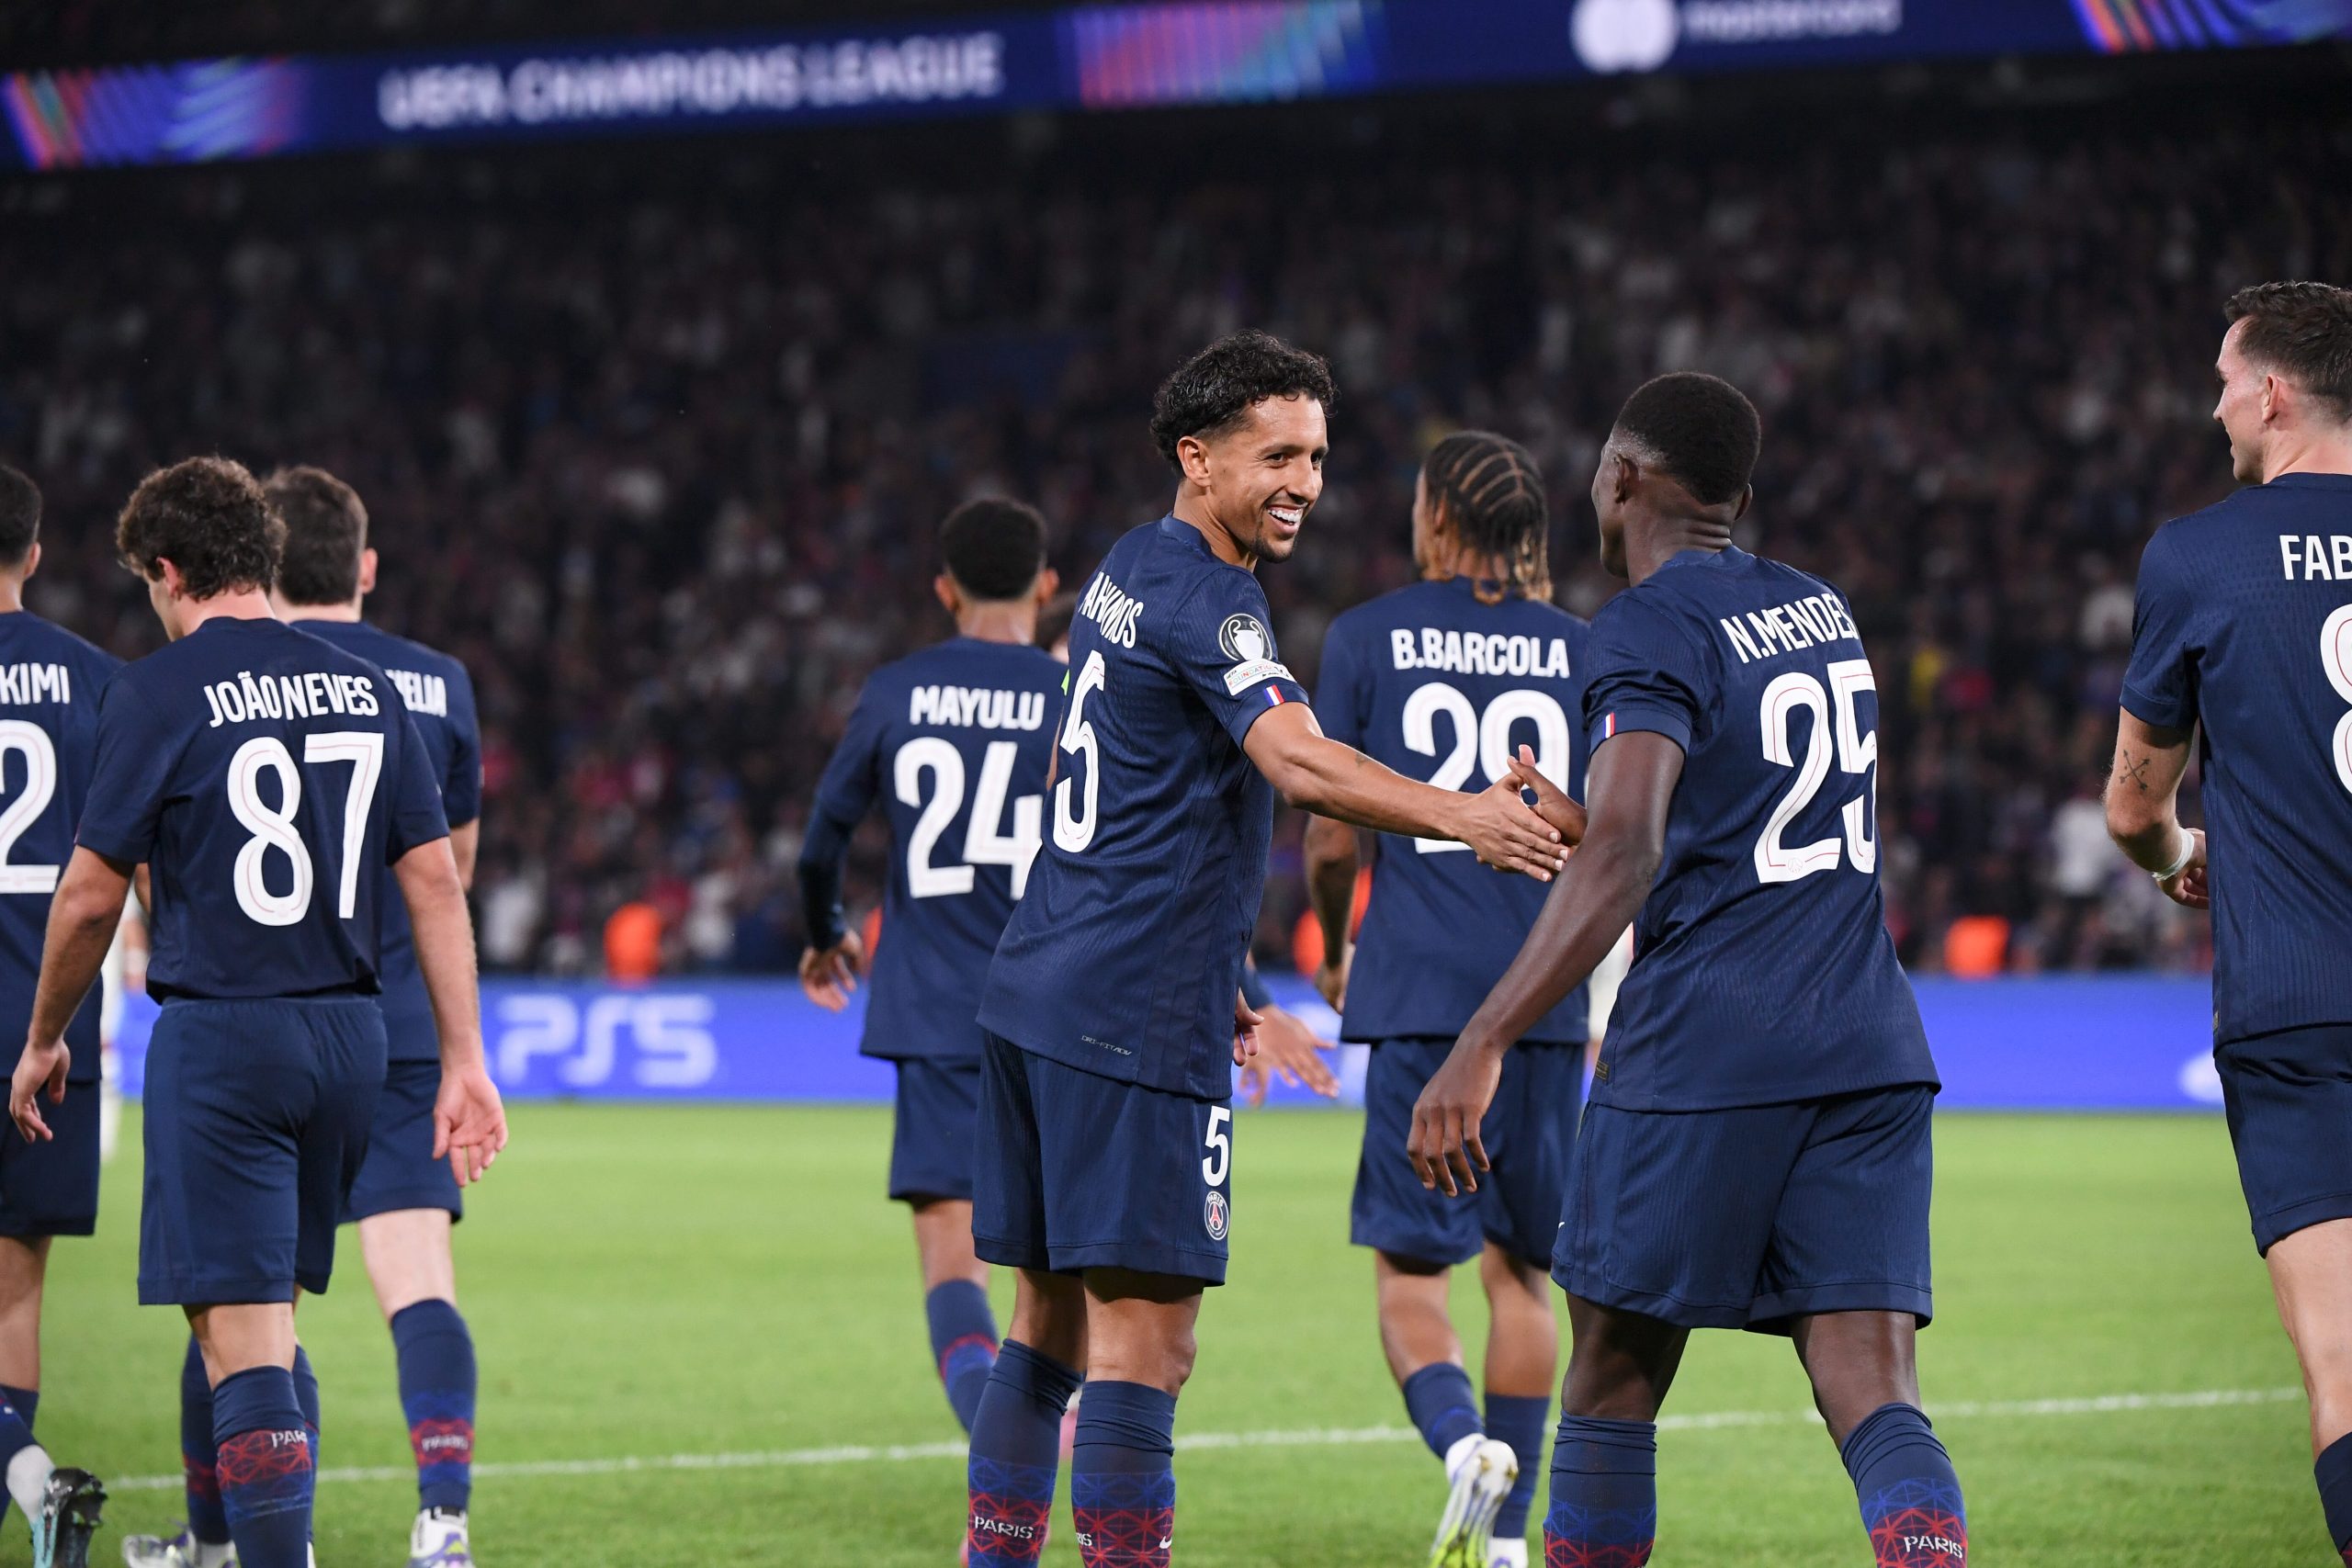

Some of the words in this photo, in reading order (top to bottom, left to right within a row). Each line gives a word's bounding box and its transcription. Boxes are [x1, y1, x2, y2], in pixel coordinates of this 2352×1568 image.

[1391, 627, 1570, 678] B.BARCOLA
[910, 684, 1046, 731] MAYULU
[1052, 649, 1105, 852] 5
[1754, 659, 1878, 884] 25
[226, 730, 385, 927] 87
[893, 736, 1044, 900] 24
[496, 992, 718, 1088] PS5
[1202, 1105, 1231, 1188] 5
[975, 1516, 1035, 1540] PARIS
[1904, 1535, 1963, 1559] PARIS
